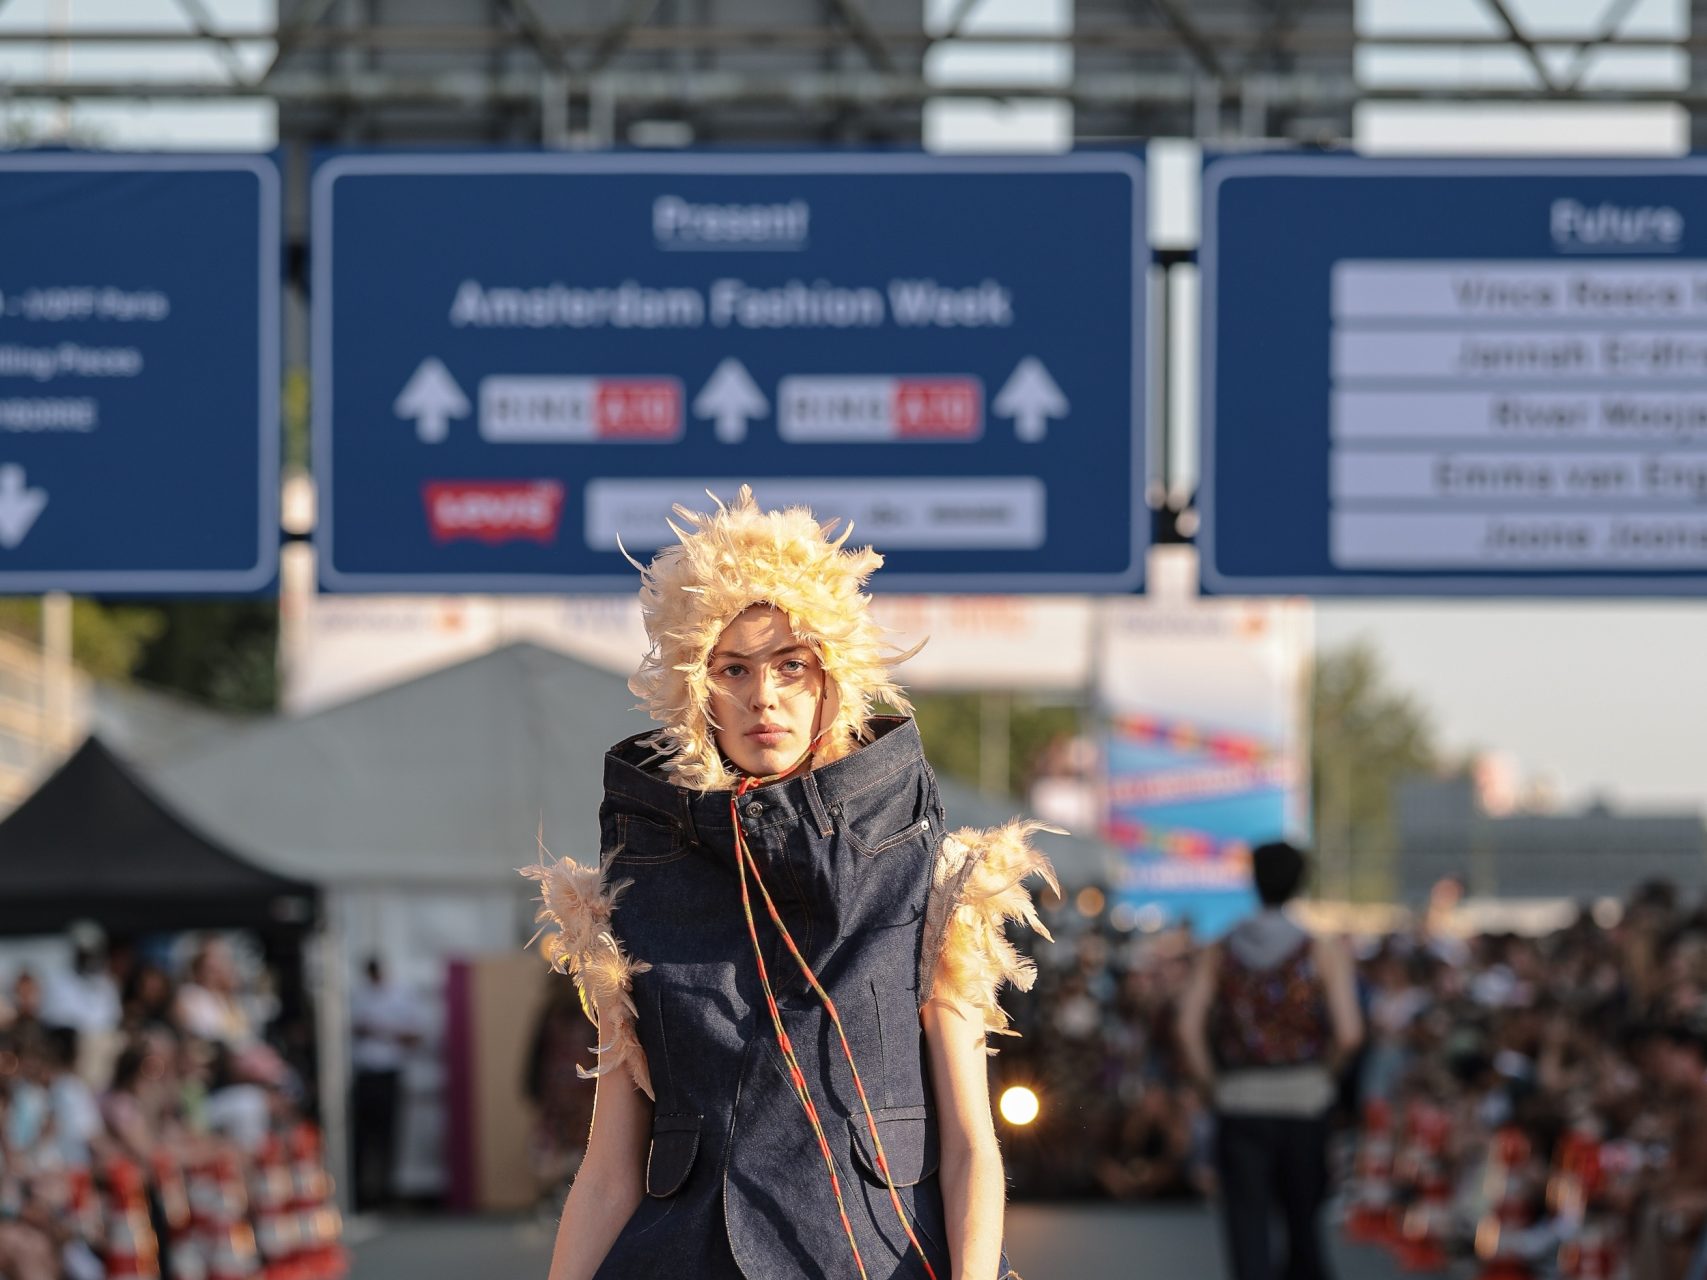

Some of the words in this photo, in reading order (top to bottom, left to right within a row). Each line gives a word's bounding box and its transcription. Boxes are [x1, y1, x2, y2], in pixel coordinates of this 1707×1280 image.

[654, 197, 807, 242] Present
[1552, 200, 1682, 243] Future
[452, 281, 702, 326] Amsterdam
[712, 281, 882, 326] Fashion
[889, 281, 1012, 326] Week
[1452, 274, 1559, 311] Vince
[1490, 396, 1592, 433] River
[1433, 456, 1555, 495] Emma
[1562, 463, 1632, 494] van
